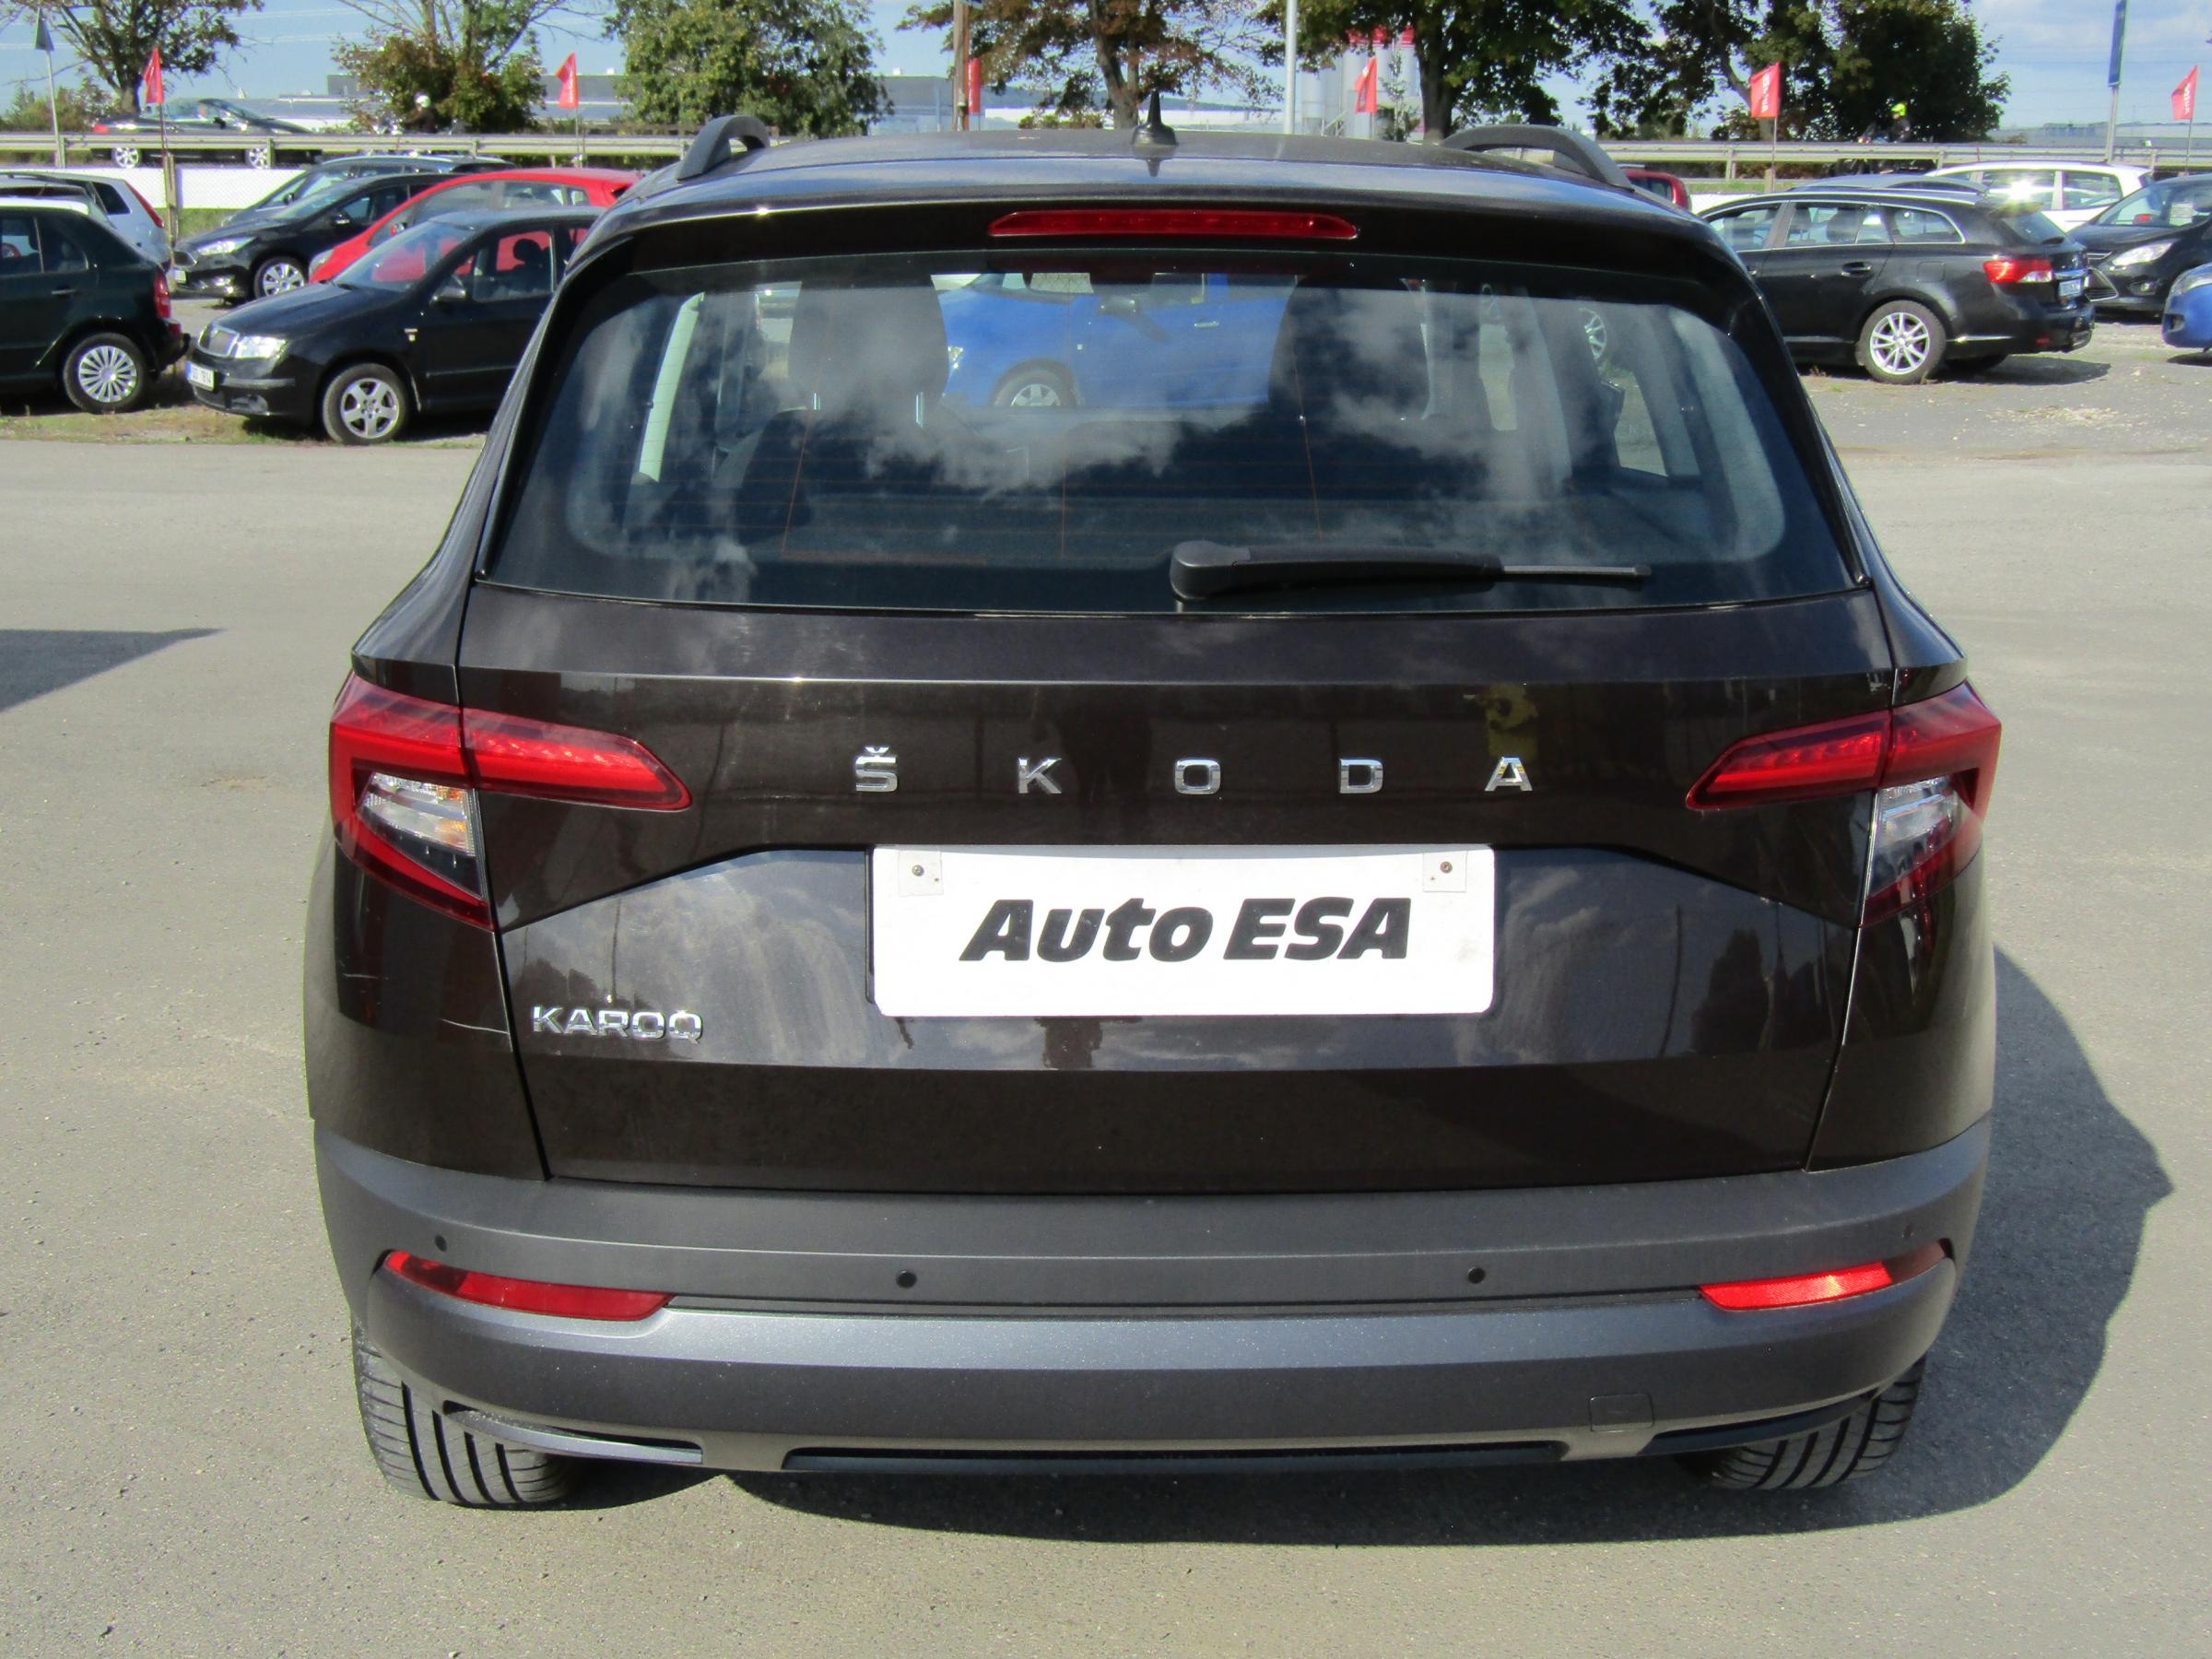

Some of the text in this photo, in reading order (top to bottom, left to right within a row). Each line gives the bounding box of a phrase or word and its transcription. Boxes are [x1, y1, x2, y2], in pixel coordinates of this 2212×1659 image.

[855, 745, 1534, 794] ŠKODA
[959, 897, 1411, 962] Auto ESA
[532, 1006, 704, 1044] KAROQ
